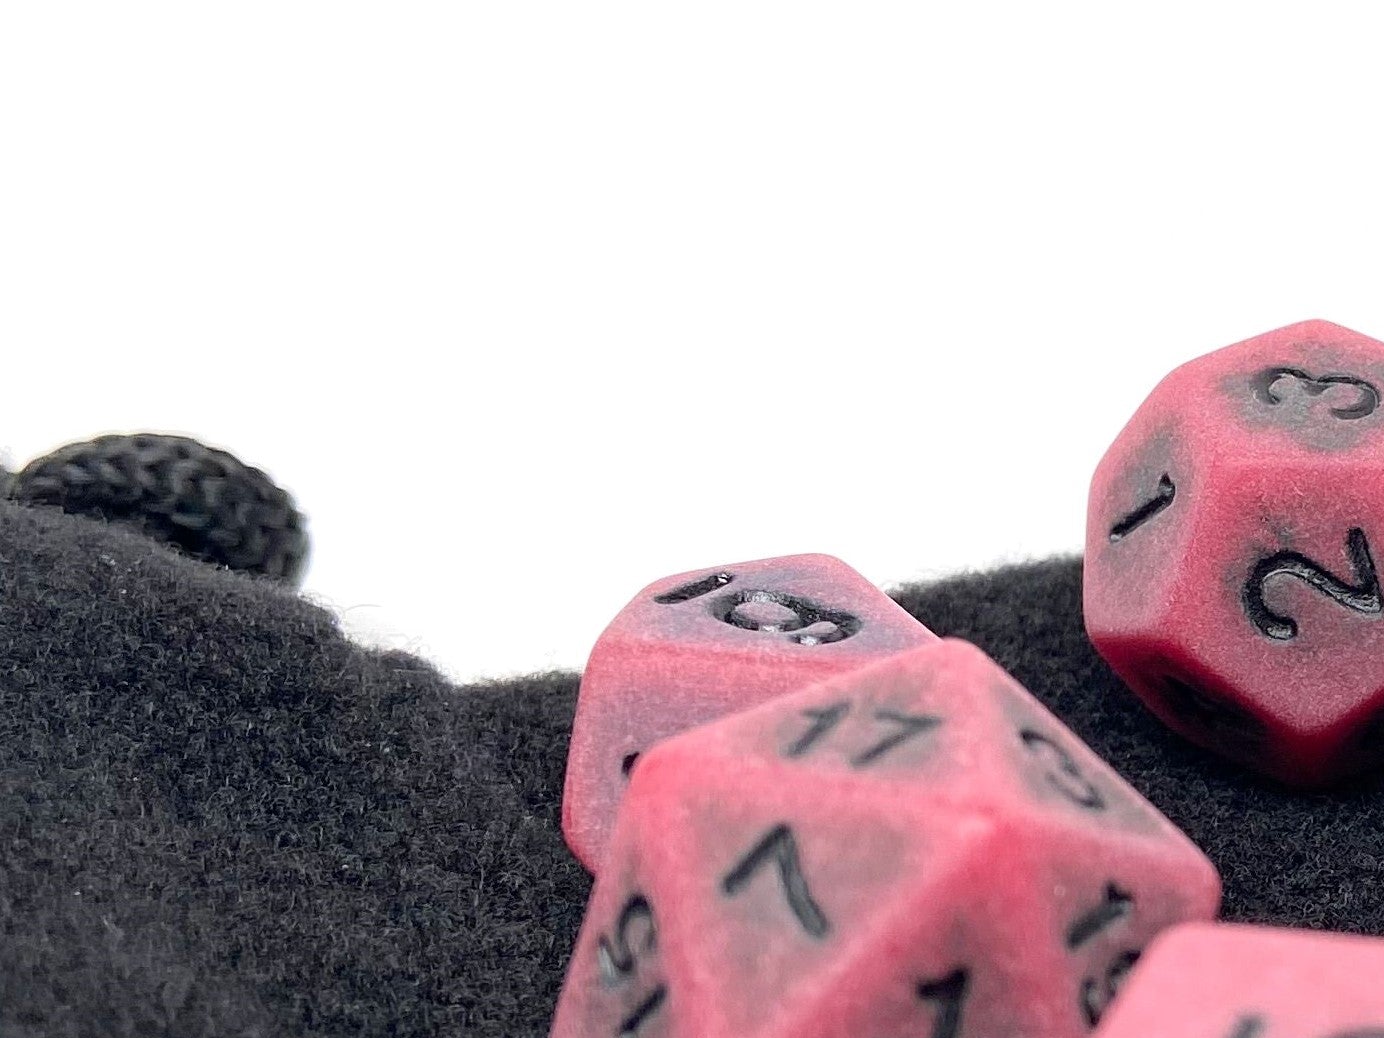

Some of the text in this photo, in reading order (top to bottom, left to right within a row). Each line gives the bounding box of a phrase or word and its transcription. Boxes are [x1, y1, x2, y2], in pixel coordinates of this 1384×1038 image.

[1256, 365, 1382, 421] 3
[1240, 526, 1384, 642] 2
[785, 700, 950, 769] 17
[722, 820, 830, 940] 7
